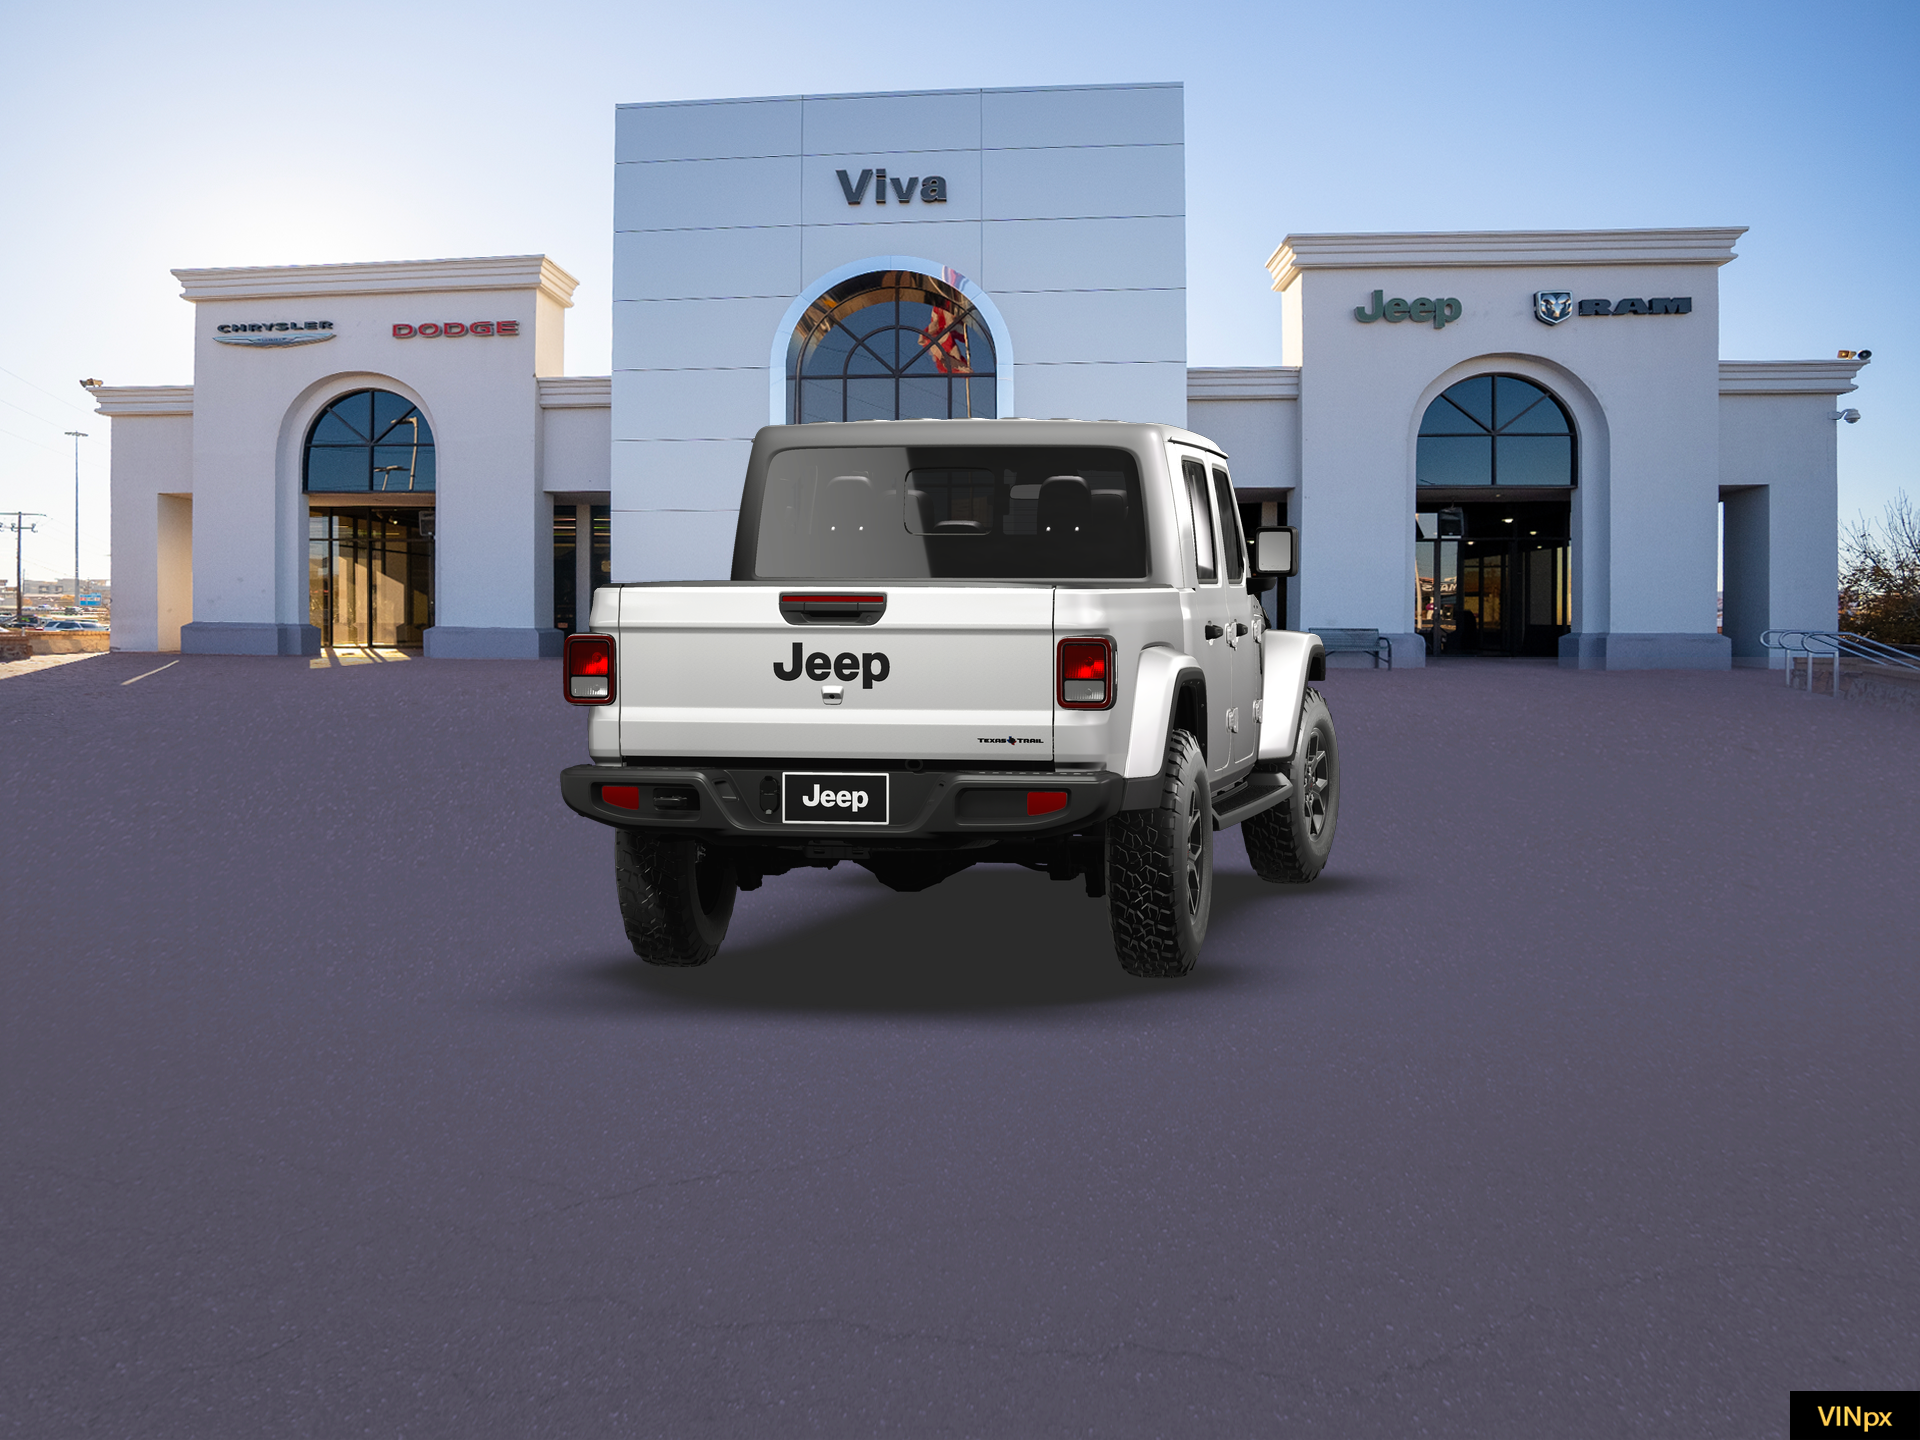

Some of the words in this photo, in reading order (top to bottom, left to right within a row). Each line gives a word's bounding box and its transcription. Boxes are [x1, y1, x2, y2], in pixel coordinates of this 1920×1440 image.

[835, 168, 947, 205] Viva
[1354, 289, 1462, 329] Jeep
[1578, 297, 1692, 316] RAM
[217, 321, 334, 333] CHRYSLER
[392, 319, 520, 339] DODGE
[773, 642, 890, 689] Jeep
[802, 784, 869, 812] Jeep
